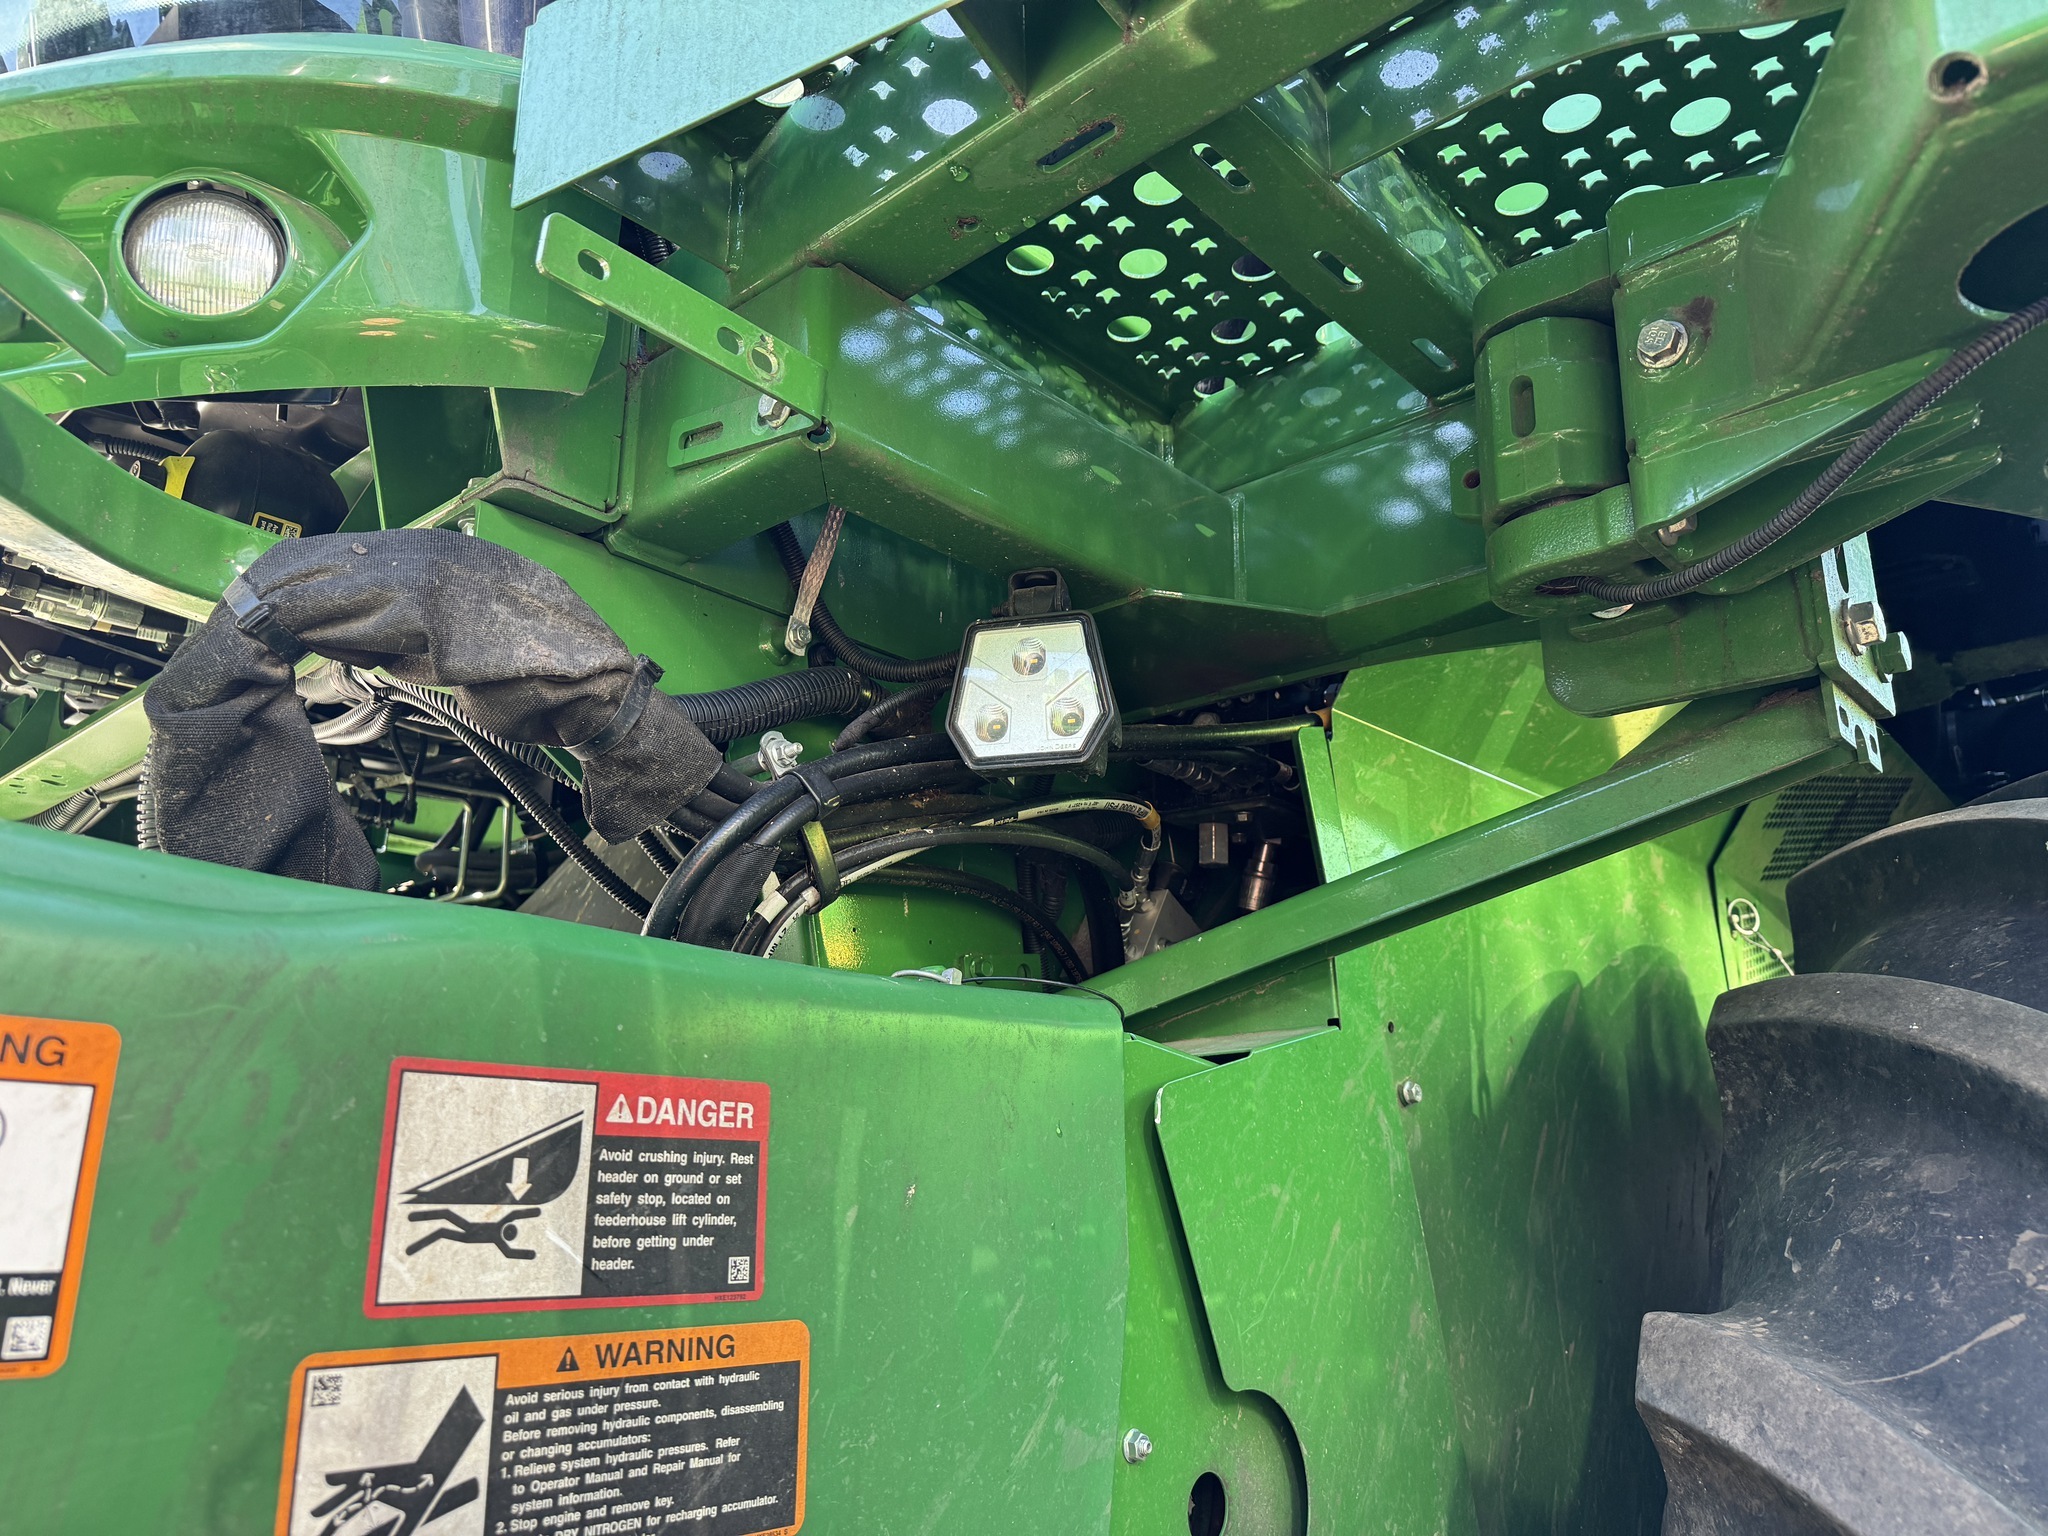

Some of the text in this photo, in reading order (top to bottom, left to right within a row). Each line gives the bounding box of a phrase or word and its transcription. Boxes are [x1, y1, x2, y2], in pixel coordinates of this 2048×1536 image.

[636, 1096, 754, 1129] DANGER
[599, 1148, 754, 1167] Avoid crushing injury. Rest
[597, 1170, 742, 1187] header on ground or set
[596, 1192, 731, 1207] safety stop, located on
[594, 1213, 737, 1229] feederhouse lift cylinder,
[593, 1234, 715, 1251] before getting under
[591, 1256, 635, 1271] header.
[595, 1334, 735, 1369] WARNING
[505, 1371, 760, 1406] Avoid serious injury from contact with hydraulic
[502, 1400, 784, 1443] Before removing hydraulic components, disassembling
[503, 1399, 661, 1425] oil and gas under pressure.
[500, 1436, 740, 1479] 1. Relieve system hydraulic pressures. Refer
[501, 1432, 651, 1462] or changing accumulators:
[512, 1452, 741, 1496] to Operator Manual and Repair Manual for
[495, 1496, 674, 1535] 2. Stop engine and remove key.
[511, 1487, 623, 1516] system information.
[584, 1517, 642, 1536] NITROGEN
[646, 1515, 661, 1526] for
[665, 1506, 717, 1524] recharging
[721, 1495, 778, 1513] accumulator.
